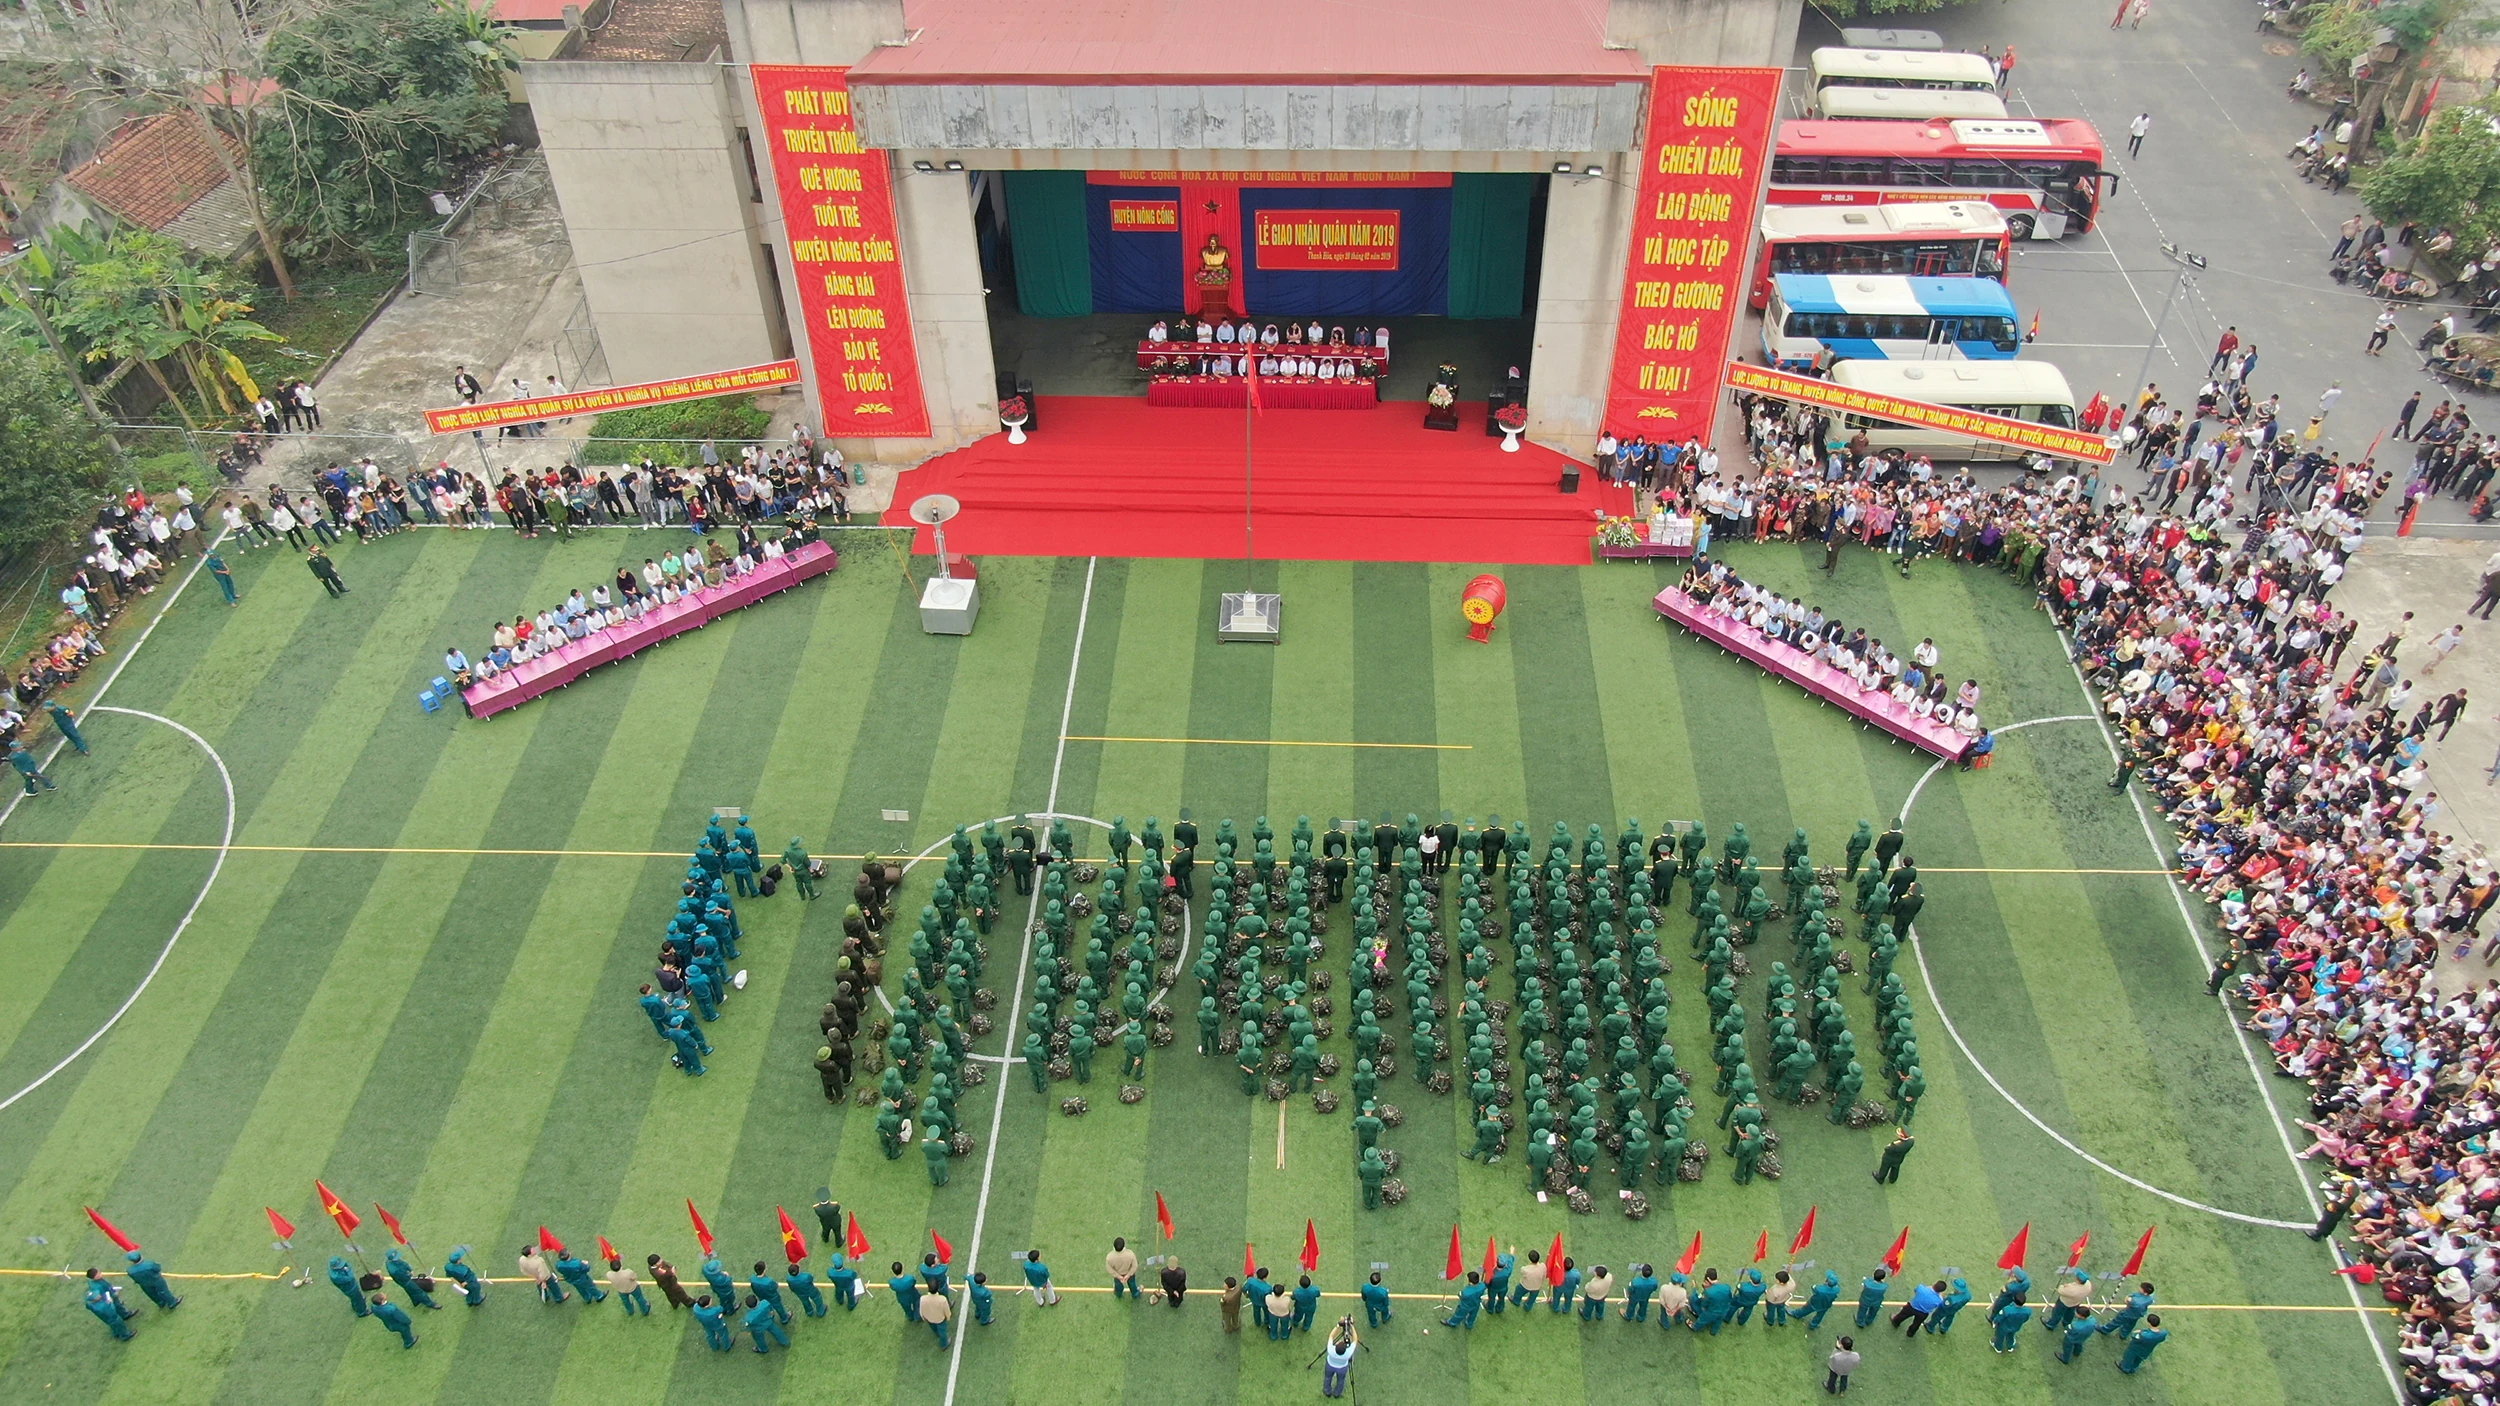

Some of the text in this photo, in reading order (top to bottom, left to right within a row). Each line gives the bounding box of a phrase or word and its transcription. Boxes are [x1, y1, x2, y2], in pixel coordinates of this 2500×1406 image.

[785, 86, 849, 115] PHÁT HUY
[1683, 87, 1738, 127] SỐNG
[783, 122, 866, 155] TRUYỀN THỐN
[1659, 136, 1744, 179] CHIẾN ĐẤU,
[800, 164, 863, 192] QUÊ HƯƠNG
[1325, 172, 1348, 181] NAM
[813, 197, 861, 228] TUỔI TRẺ
[1114, 204, 1175, 227] HUYỆN NÔNG CỐNG
[1656, 188, 1732, 227] LAO ĐỘNG
[1258, 216, 1395, 250] LỄ GIAO NHẬN QUÂN NĂM 2019
[793, 234, 894, 266] HUYỆN NÔNG CỐNG
[1644, 232, 1730, 272] VÀ HỌC TẬP
[824, 271, 875, 296] HĂNG HÁI
[1634, 280, 1724, 311] THEO GƯƠNG
[826, 304, 885, 329] LÊN ĐƯỜNG
[843, 333, 881, 365] BẢO VỆ
[1644, 318, 1700, 351] BÁC HỒ
[842, 365, 893, 394] TỔ QUỐC !
[1639, 361, 1691, 396] VĨ ĐẠI !
[437, 367, 792, 429] THỰC HIỆN LUẬT NGHĨA VỤ QUÂN SỰ LÀ QUYỀN VÀ NGHĨA VỤ THIÊNG LIÊNG CỦA MỖI CÔNG DÂN !
[1733, 369, 1746, 383] LỰC
[1746, 372, 1769, 389] LƯỢNG
[1769, 376, 1779, 390] VŨ
[1779, 380, 1802, 395] TRANG
[1802, 383, 1826, 401] HUYỆN
[1826, 387, 1846, 405] NÔNG
[1846, 391, 1866, 408] CỐNG
[1866, 395, 1889, 413] QUYẾT
[1889, 401, 1904, 416] TÂM
[1904, 403, 1924, 420] HOÀN
[1925, 408, 1950, 425] THÀNH
[1950, 413, 1969, 431] XUẤT
[1968, 417, 1985, 433] SẮC
[1984, 422, 2008, 440] NHIỆM
[2009, 427, 2019, 442] VỤ
[2043, 433, 2064, 449] QUÂN
[2064, 435, 2083, 452] NĂM
[2082, 442, 2102, 457] 2019
